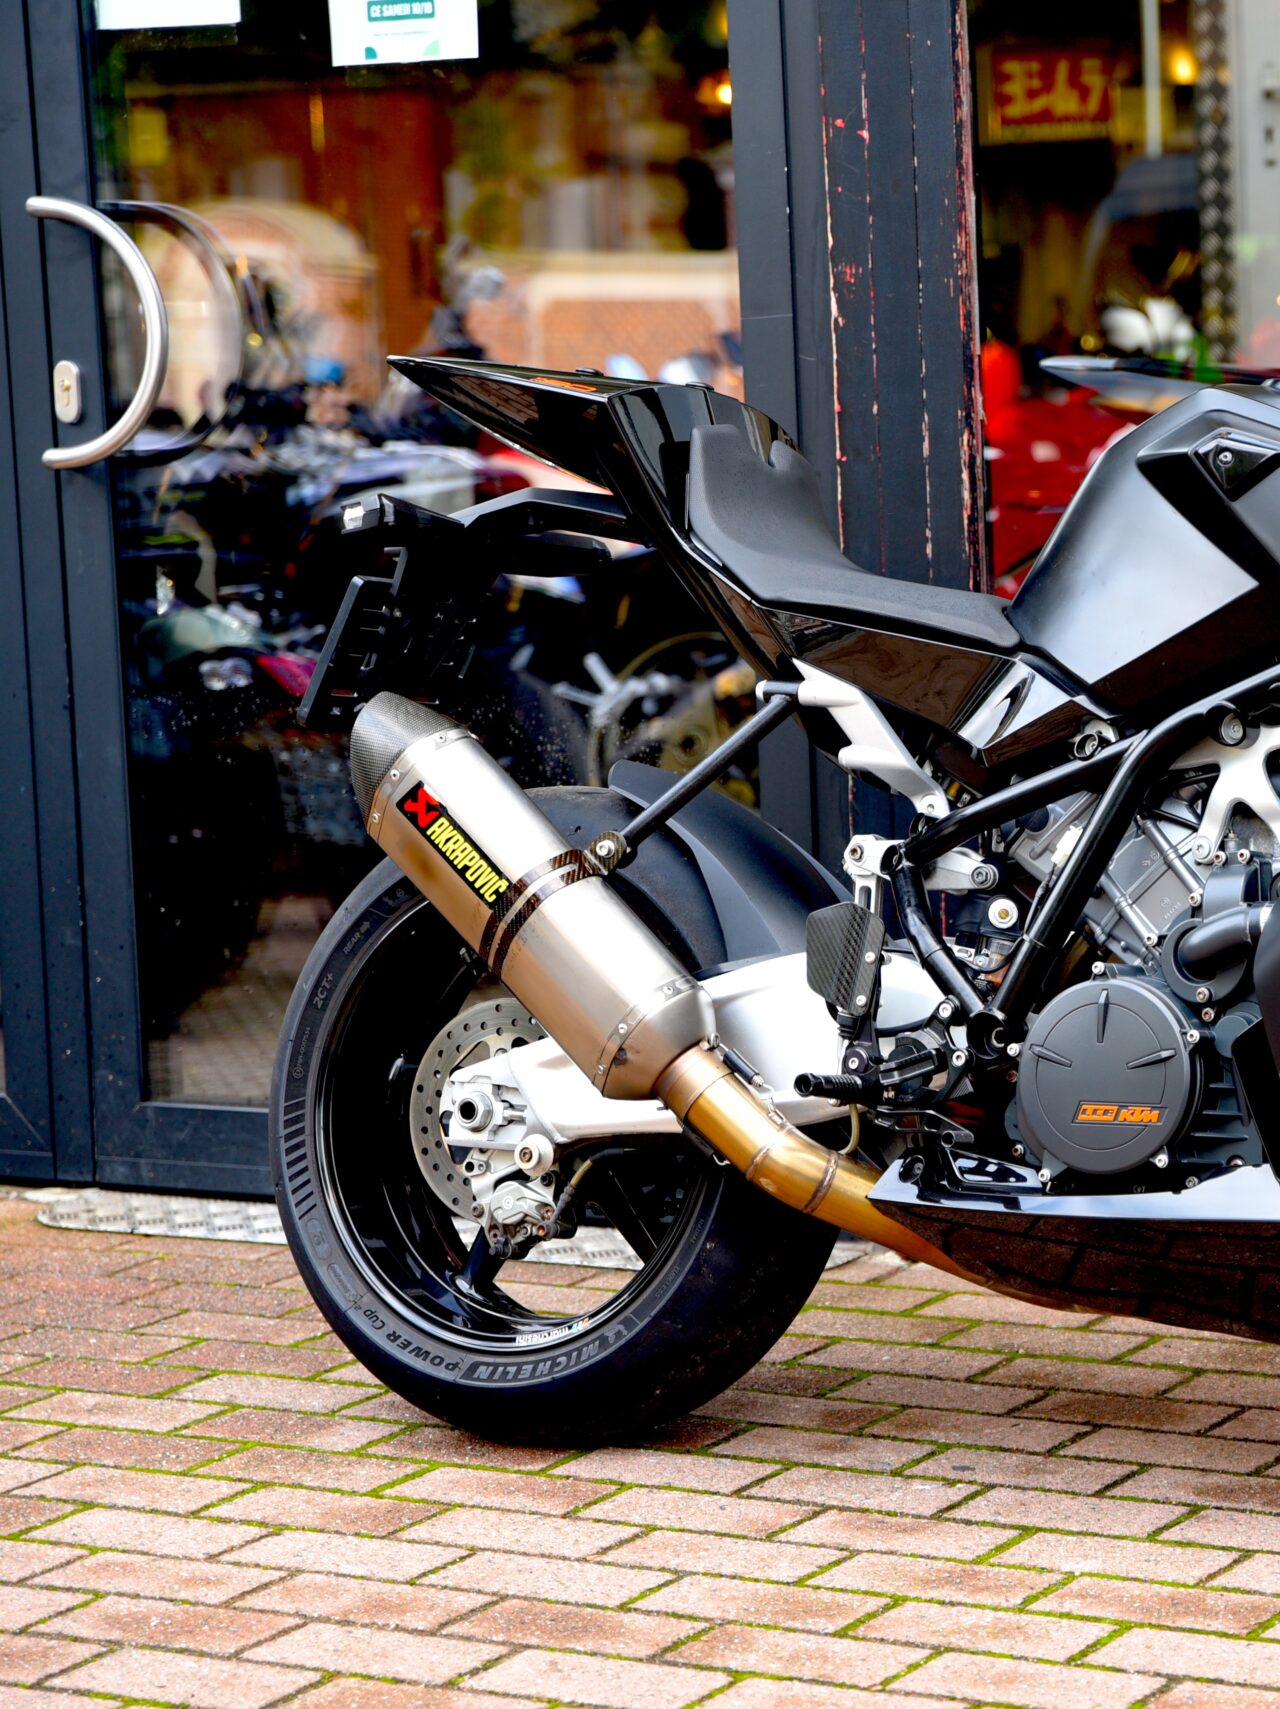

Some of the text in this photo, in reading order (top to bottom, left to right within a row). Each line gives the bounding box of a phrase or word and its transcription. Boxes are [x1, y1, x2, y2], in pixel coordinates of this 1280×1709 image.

[382, 3, 411, 17] SAMEDI
[1118, 1106, 1160, 1123] KTM
[363, 1308, 386, 1330] Cup
[386, 1330, 461, 1372] POWER
[473, 1339, 601, 1380] MICHELIN
